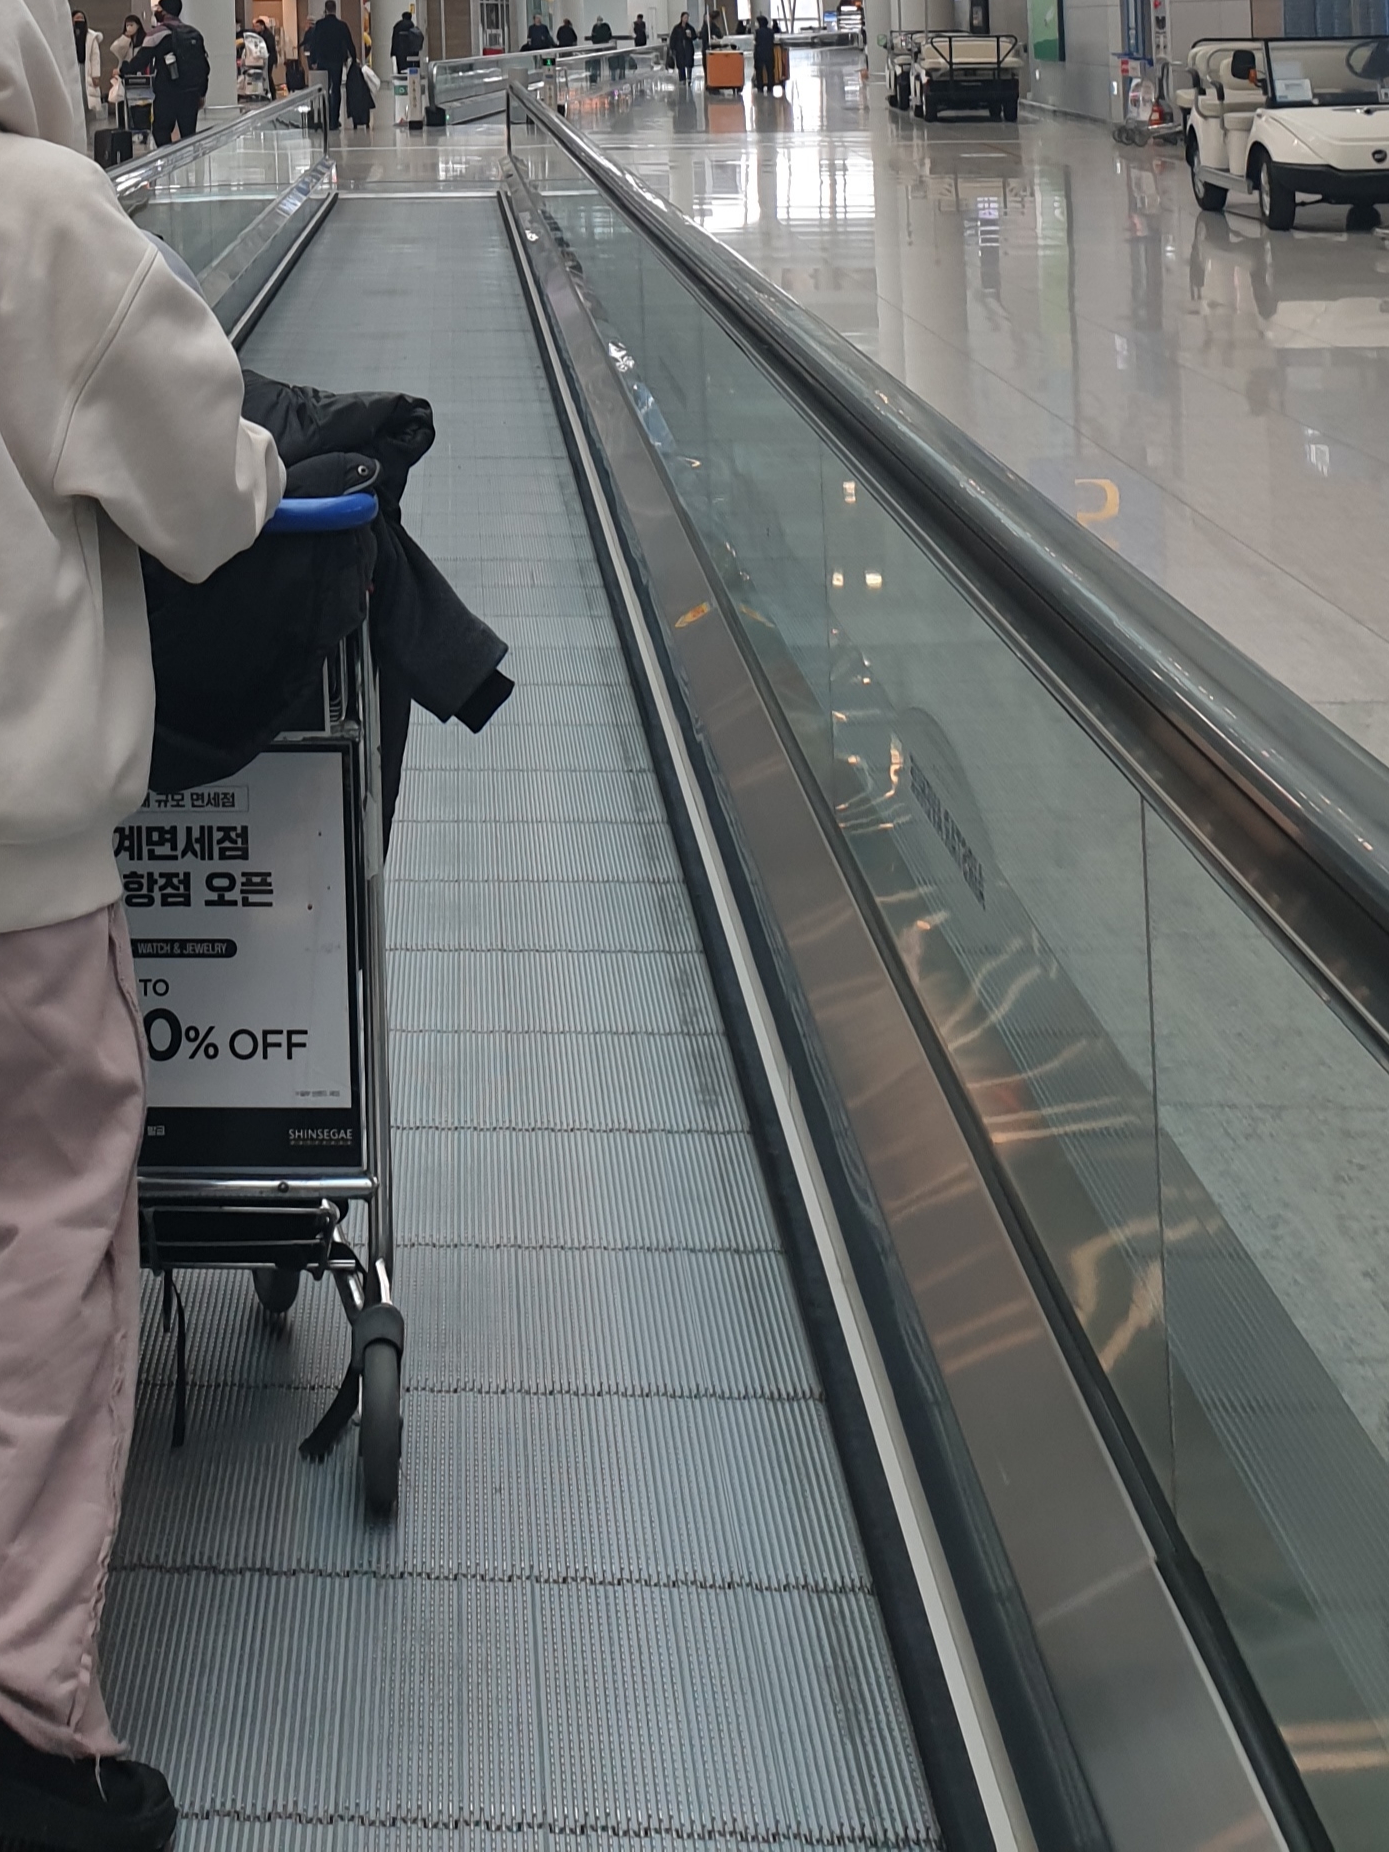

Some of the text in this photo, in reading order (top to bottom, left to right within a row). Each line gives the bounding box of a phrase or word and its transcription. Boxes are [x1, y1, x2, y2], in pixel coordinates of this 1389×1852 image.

[155, 792, 185, 808] 규모
[190, 792, 236, 808] 면세점
[122, 871, 274, 907] 항점 오픈
[137, 942, 228, 955] WATCH & JEWELRY
[138, 978, 170, 997] TO
[228, 1028, 308, 1061] OFF
[288, 1128, 353, 1139] SHINSEGAE
